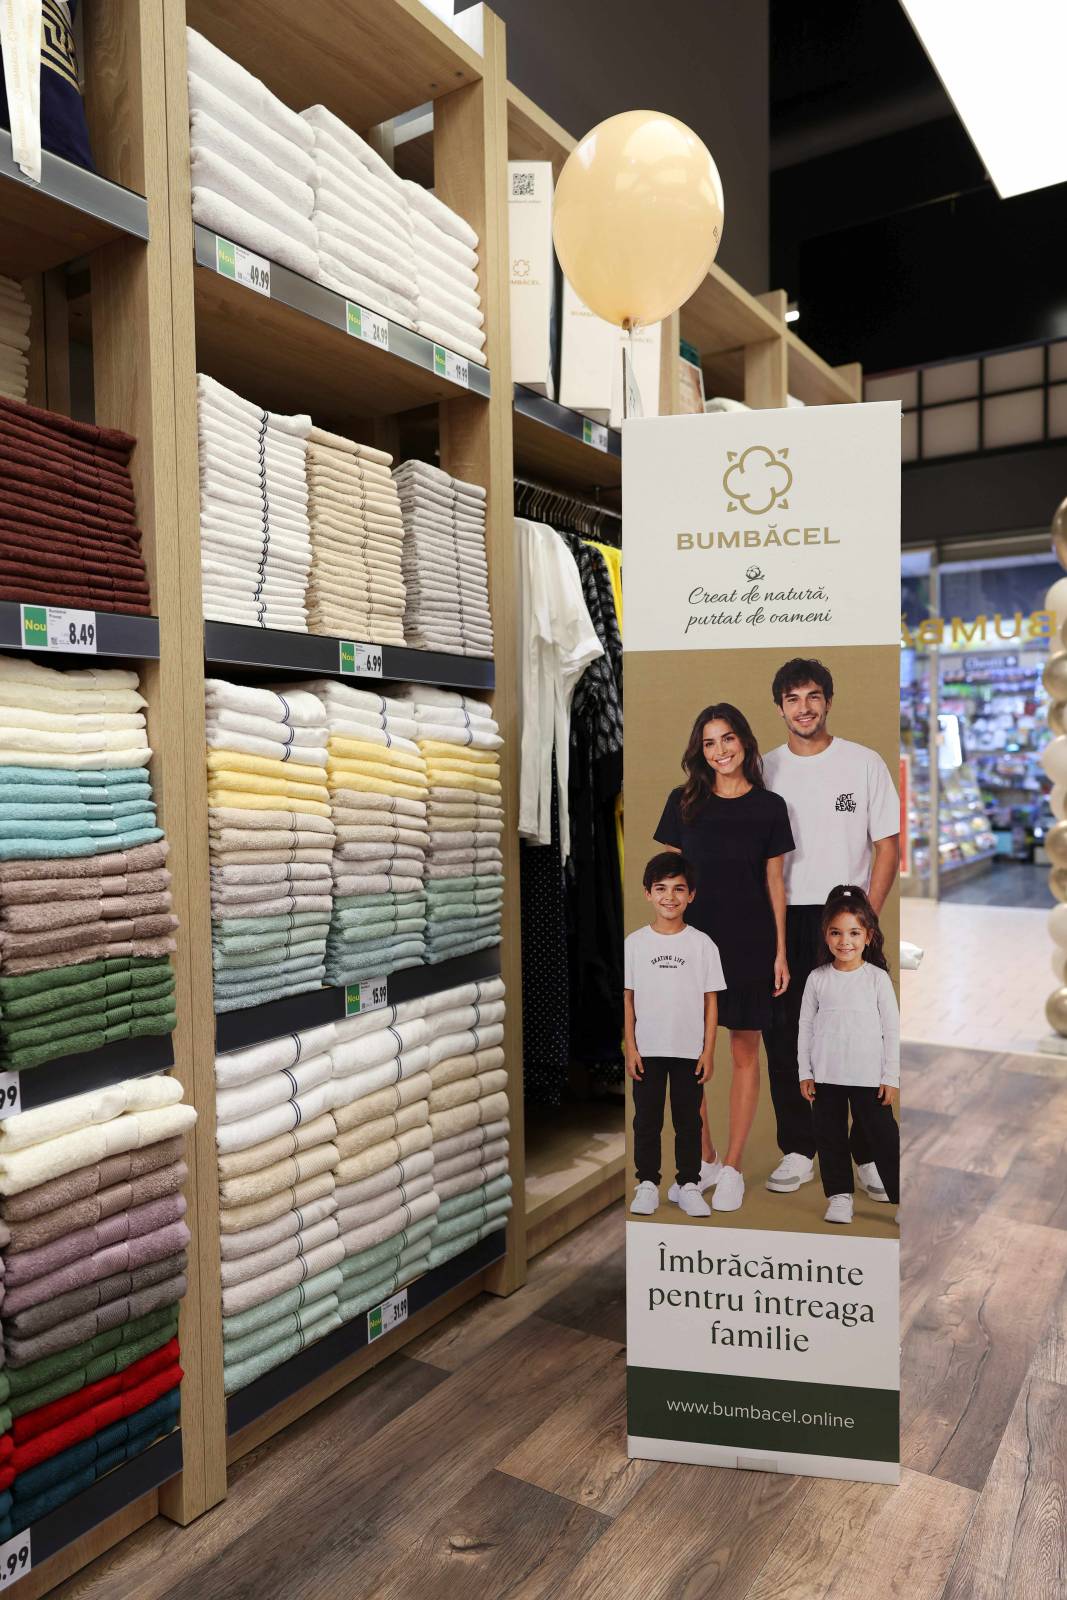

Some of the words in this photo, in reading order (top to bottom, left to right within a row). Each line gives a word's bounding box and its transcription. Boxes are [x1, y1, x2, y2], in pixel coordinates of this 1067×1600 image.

[250, 264, 270, 290] 49.99
[676, 523, 841, 550] BUMBĂCEL
[688, 586, 737, 605] Creat
[740, 584, 760, 605] de
[764, 586, 829, 603] natură,
[25, 619, 47, 632] Nou
[684, 610, 742, 634] purtat
[745, 606, 765, 627] de
[769, 609, 832, 623] oameni
[69, 622, 95, 646] 8.49
[366, 654, 382, 672] 6.99
[835, 805, 856, 813] READY
[836, 792, 854, 801] NEXT
[650, 955, 673, 965] SKATING
[673, 956, 686, 966] LIFE
[372, 985, 387, 1005] 15.99
[658, 1241, 864, 1286] Îmbrăcăminte
[648, 1286, 744, 1312] pentru
[753, 1289, 875, 1327] întreaga
[711, 1320, 809, 1352] familie
[666, 1399, 855, 1429] www.bumbacel.online
[0, 1545, 29, 1580] .99
